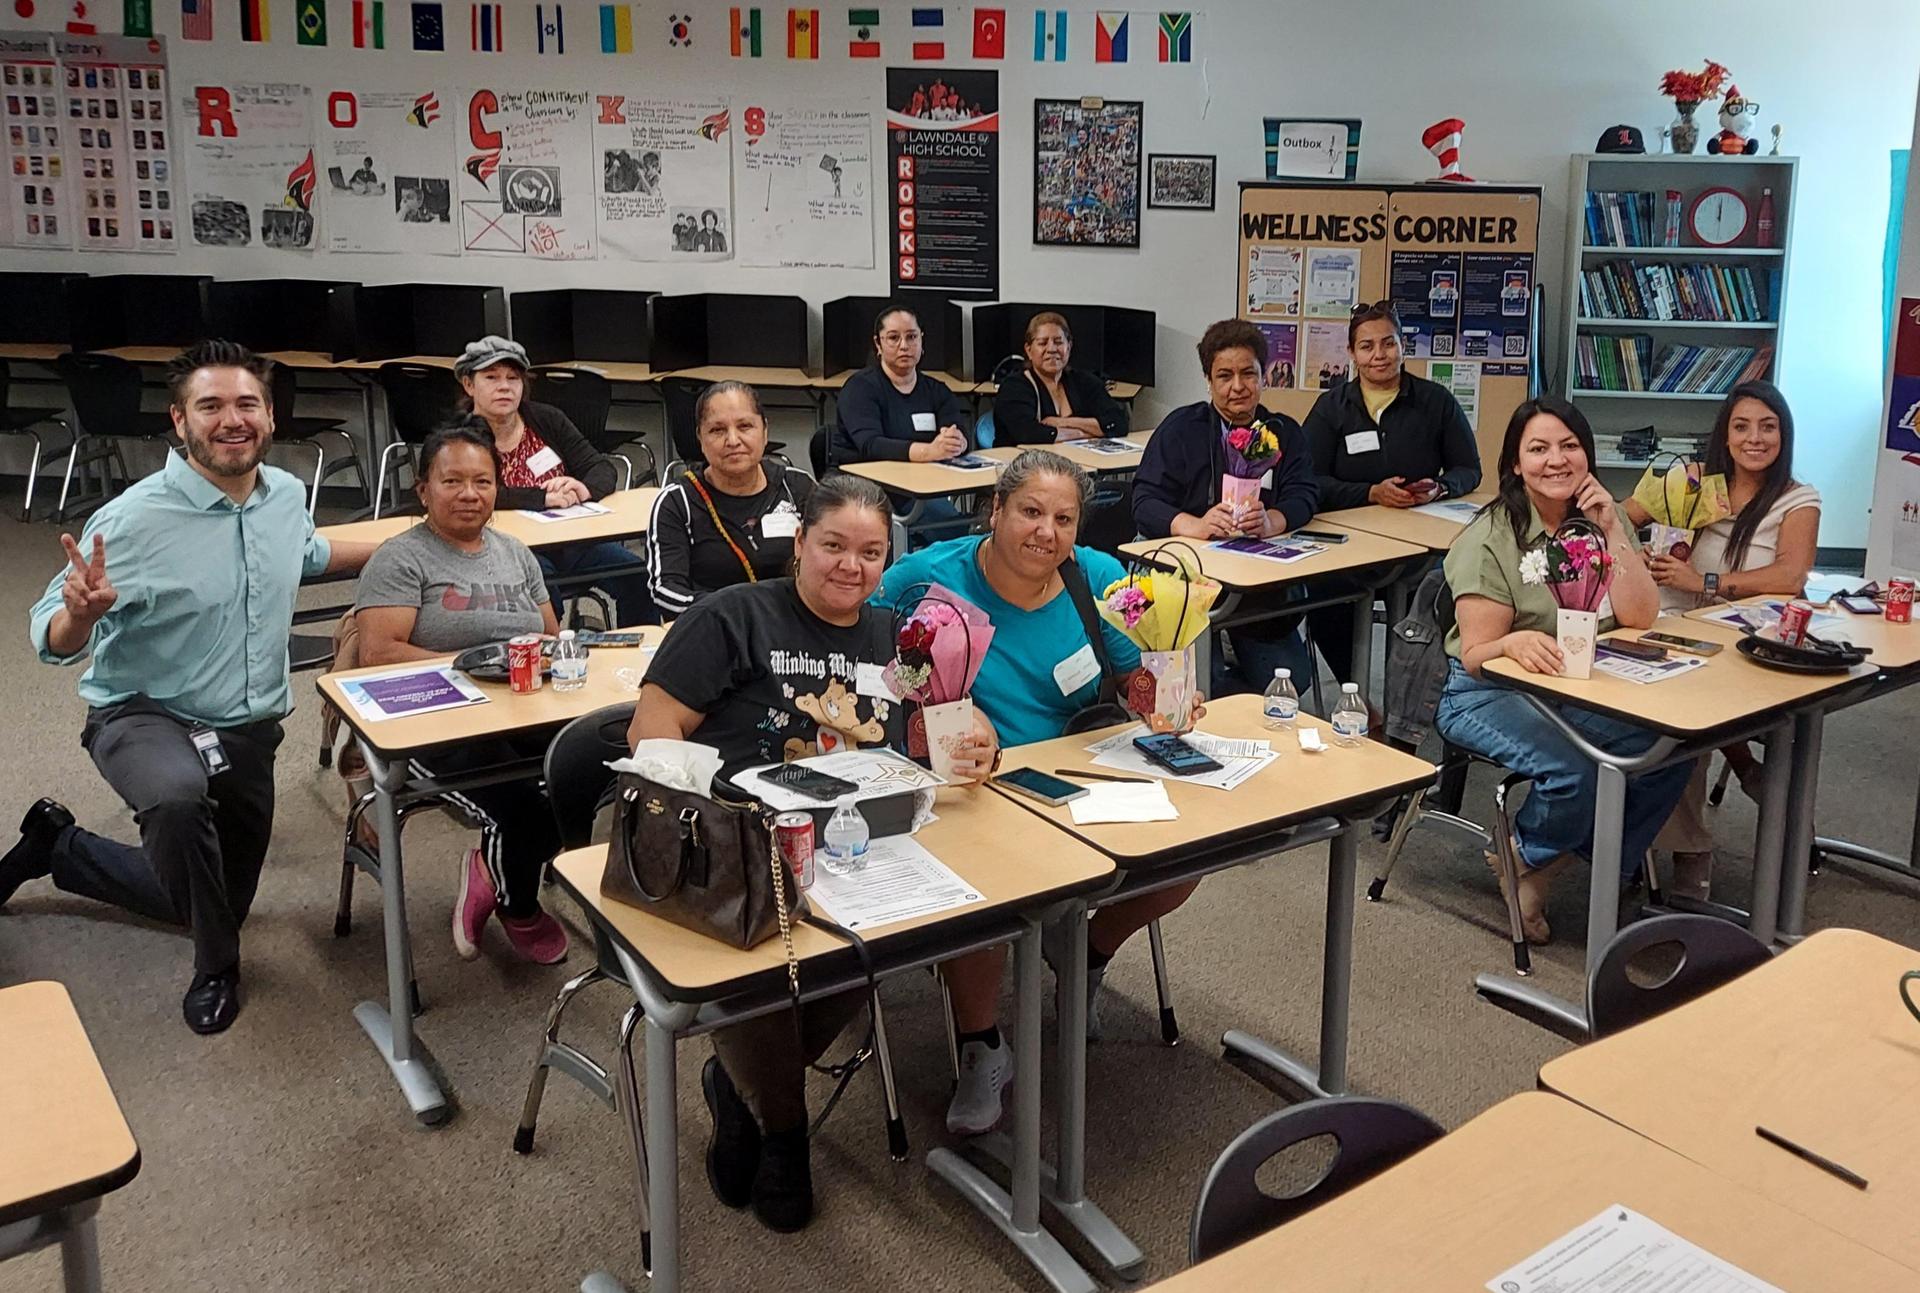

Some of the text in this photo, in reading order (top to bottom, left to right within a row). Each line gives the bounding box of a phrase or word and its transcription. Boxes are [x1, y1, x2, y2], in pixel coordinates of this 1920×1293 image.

[195, 86, 238, 138] R
[328, 91, 357, 129] O
[468, 89, 504, 150] C
[597, 95, 625, 124] K
[903, 144, 986, 157] HIGH SCHOOL
[909, 131, 977, 144] LAWNDALE
[1283, 138, 1322, 149] Outbox
[1243, 213, 1518, 244] WELLNESS CORNER
[769, 650, 826, 680] Minding
